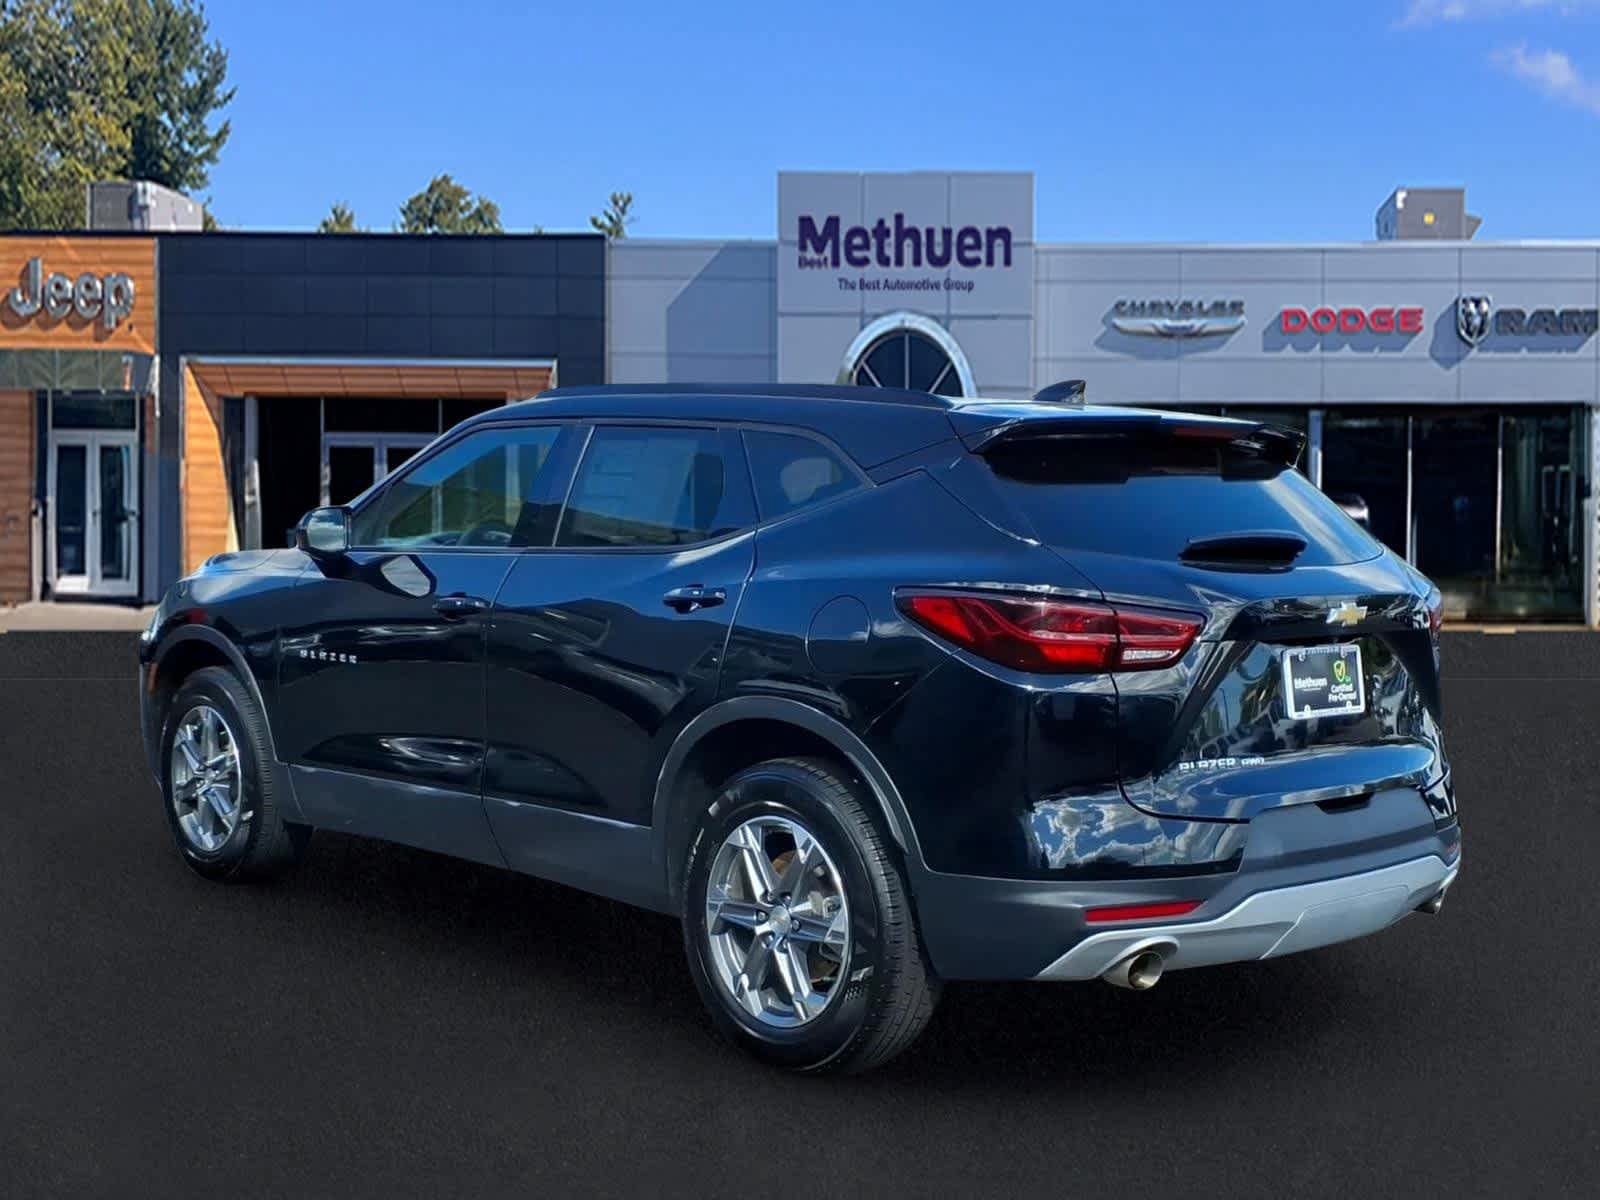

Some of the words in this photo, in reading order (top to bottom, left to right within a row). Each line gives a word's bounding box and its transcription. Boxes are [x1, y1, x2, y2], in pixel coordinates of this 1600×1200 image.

[798, 212, 1012, 269] Methuen
[798, 255, 829, 269] Best
[9, 256, 135, 330] Jeep
[838, 278, 856, 291] The
[859, 278, 880, 291] Best
[883, 277, 941, 291] Automotive
[943, 277, 975, 293] Group
[1113, 299, 1245, 319] CHRYSLER
[1282, 307, 1424, 334] DODGE
[1494, 307, 1599, 337] RAM
[1294, 676, 1328, 690] Methuen
